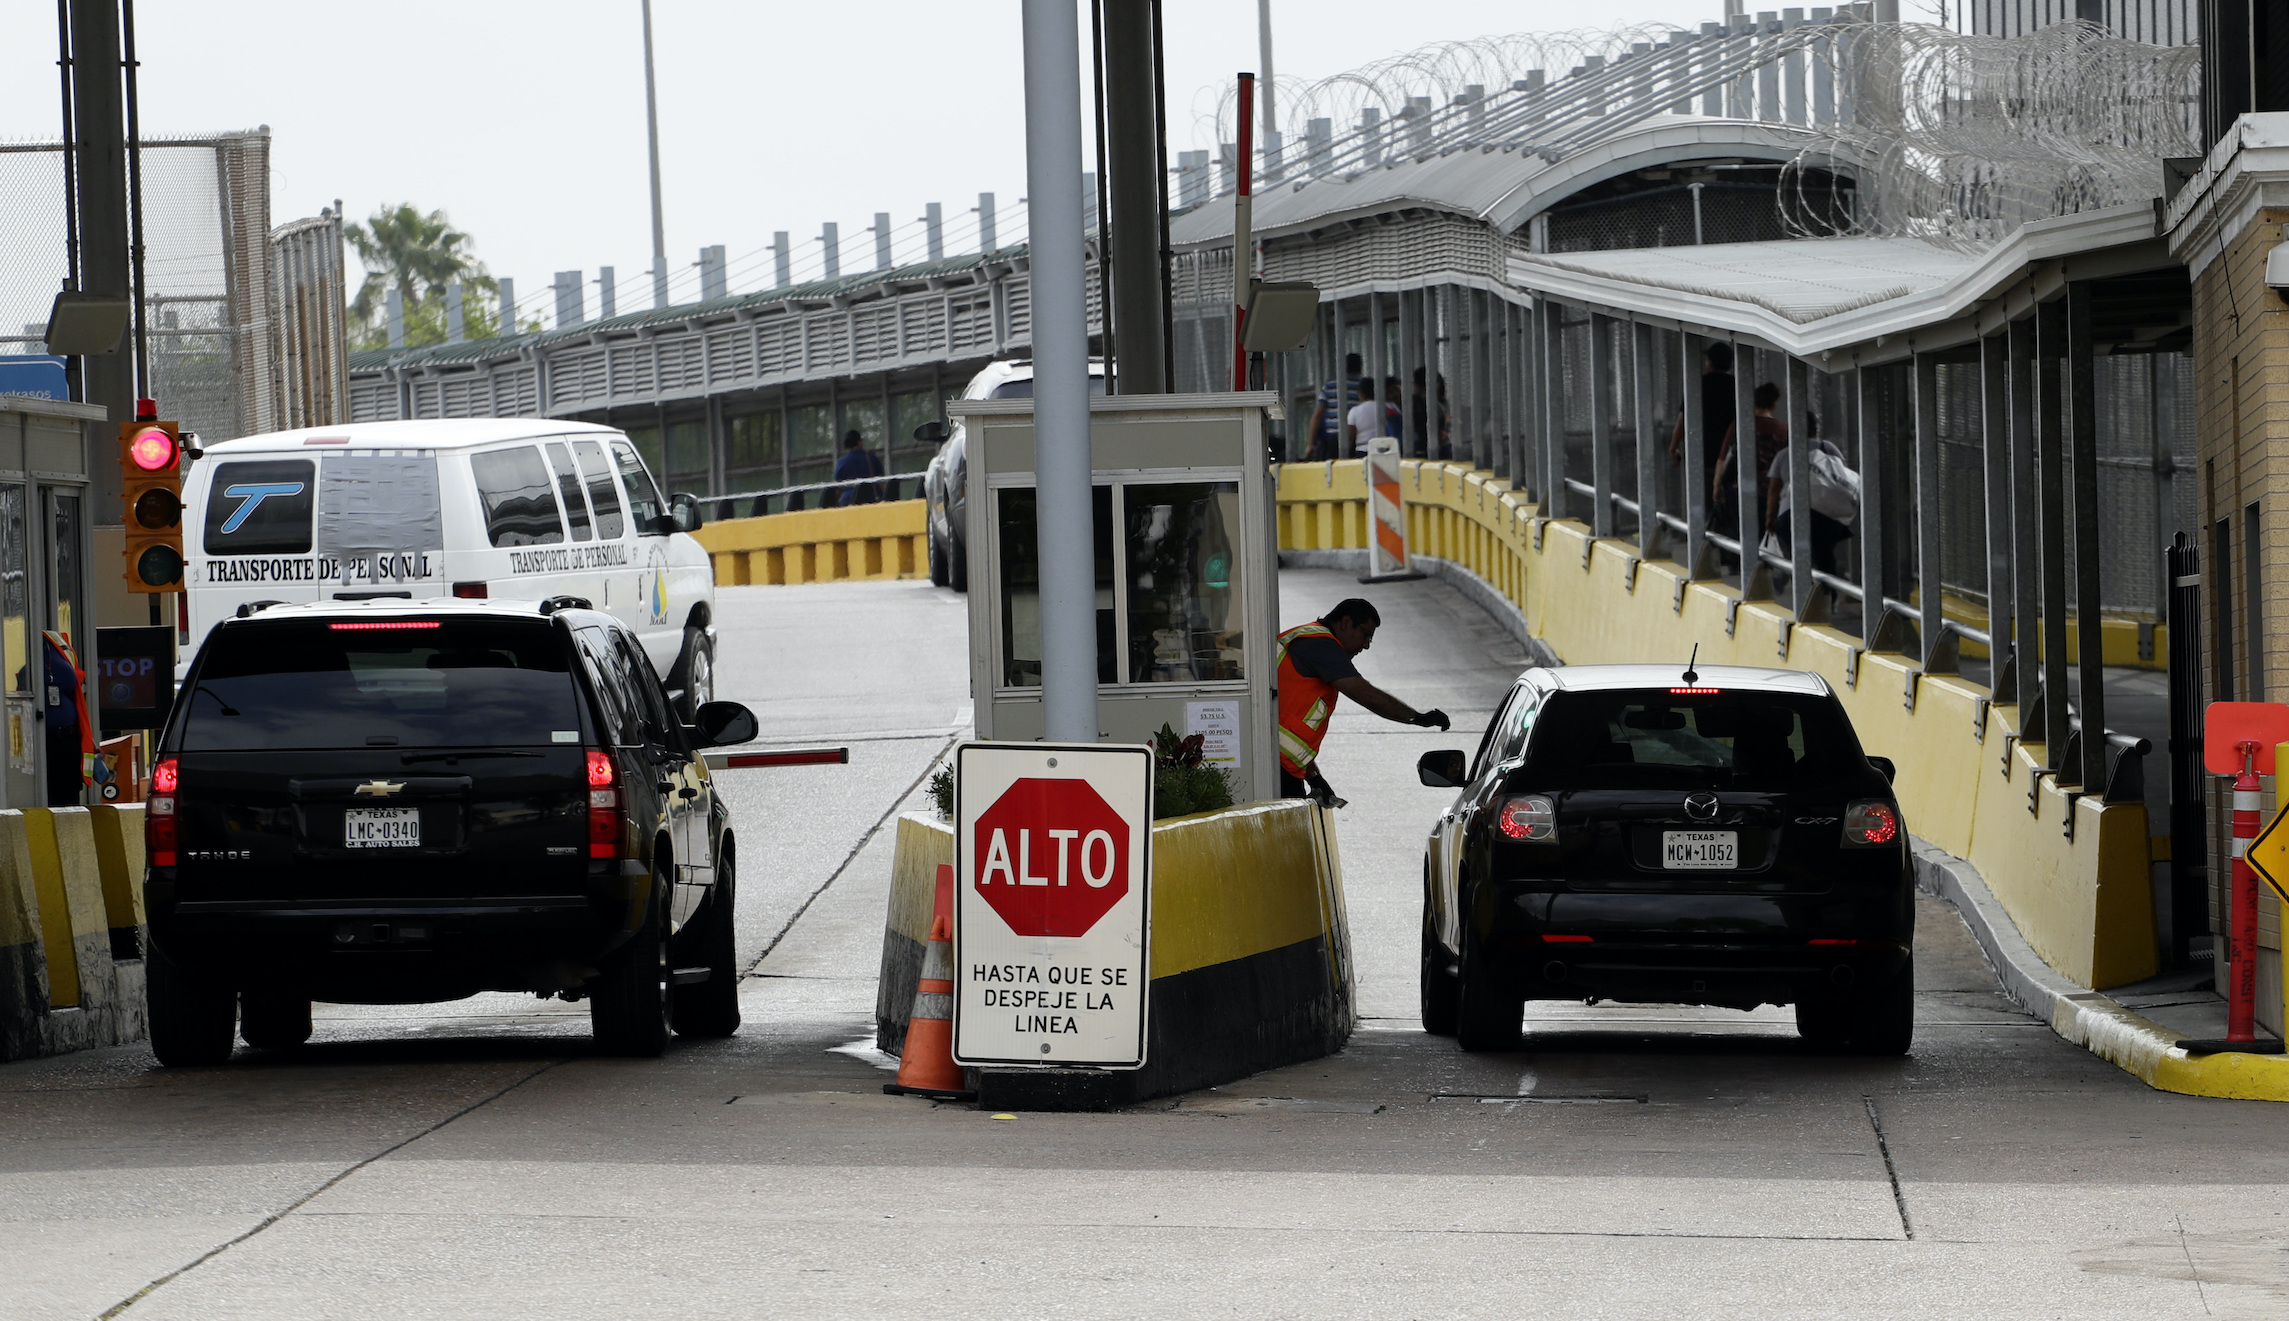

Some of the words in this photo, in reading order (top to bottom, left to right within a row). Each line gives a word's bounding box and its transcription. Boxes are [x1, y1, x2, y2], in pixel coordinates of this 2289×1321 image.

[510, 549, 569, 574] TRANSPORTE
[571, 548, 585, 569] DE
[585, 544, 628, 568] PERSONAL
[206, 558, 314, 582] TRANSPORTE
[319, 558, 341, 580] DE
[367, 811, 398, 819] TEXAS
[345, 840, 364, 848] C.H.
[365, 840, 390, 848] AUTO
[1686, 833, 1715, 841] TEXAS
[980, 827, 1116, 889] ALTO
[973, 964, 1040, 984] HASTA
[1048, 966, 1093, 985] QUE
[1100, 968, 1128, 986] SE
[984, 989, 1077, 1010] DESPEJE
[1086, 992, 1114, 1010] LA
[1015, 1015, 1078, 1034] LINEA
